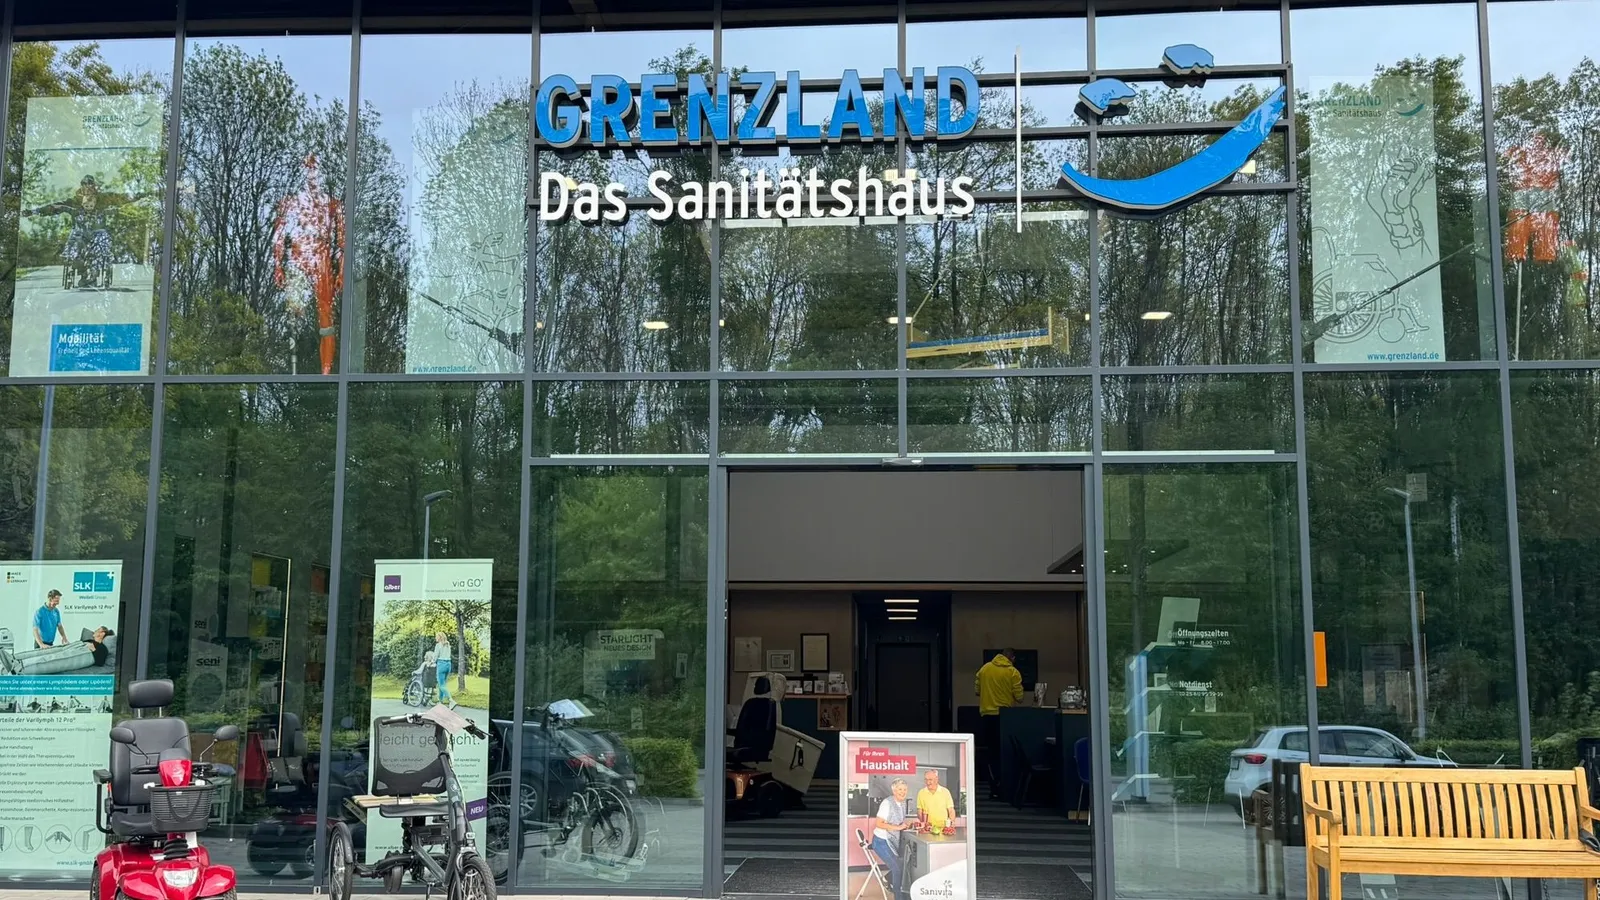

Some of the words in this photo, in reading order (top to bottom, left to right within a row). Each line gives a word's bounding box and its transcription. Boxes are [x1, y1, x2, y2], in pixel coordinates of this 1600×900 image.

[535, 66, 980, 146] GRENZLAND
[540, 172, 627, 221] Das
[647, 166, 976, 220] Sanitätshaus
[58, 333, 104, 344] Mobilität
[1367, 352, 1440, 361] www.grenzland.de
[74, 581, 92, 590] SLK
[452, 578, 465, 587] via
[1178, 628, 1229, 638] Öffnungszeiten
[600, 634, 653, 644] STARLIGHT
[196, 656, 221, 666] seni
[1179, 680, 1213, 688] Notdienst
[860, 759, 910, 771] Haushalt
[470, 805, 485, 815] NEU
